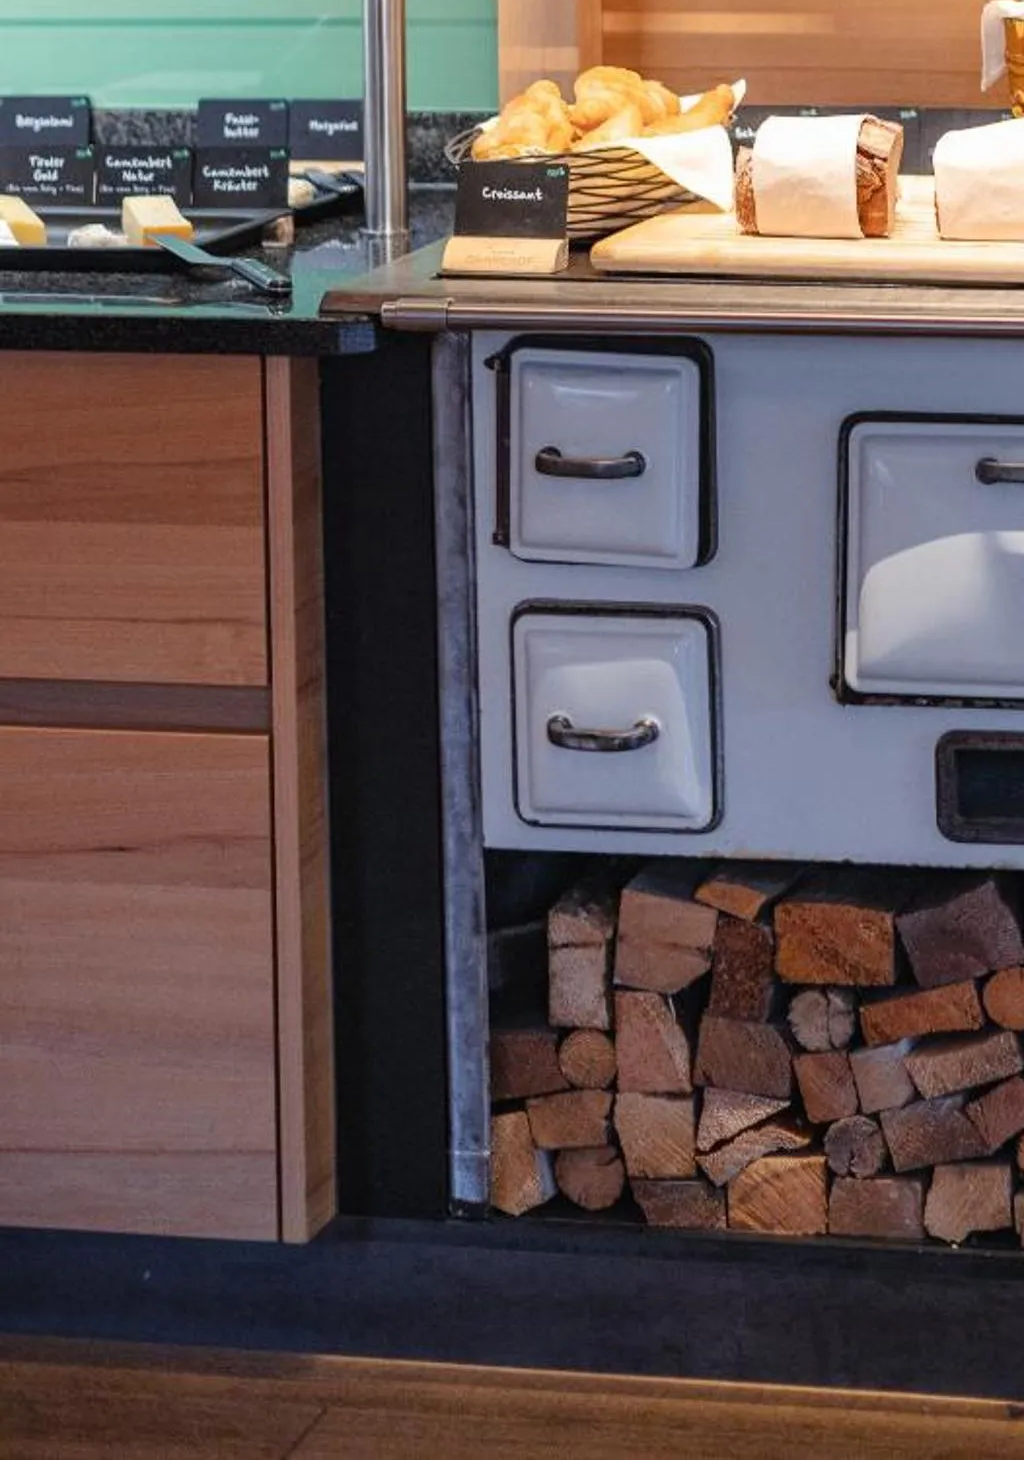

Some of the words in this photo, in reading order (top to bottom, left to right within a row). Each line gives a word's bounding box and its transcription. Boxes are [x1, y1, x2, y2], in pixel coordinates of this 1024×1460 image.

[105, 155, 173, 169] Camembert
[33, 169, 59, 182] Gold
[122, 169, 155, 182] Natur
[202, 165, 270, 178] Camembert
[482, 187, 543, 201] Croissant
